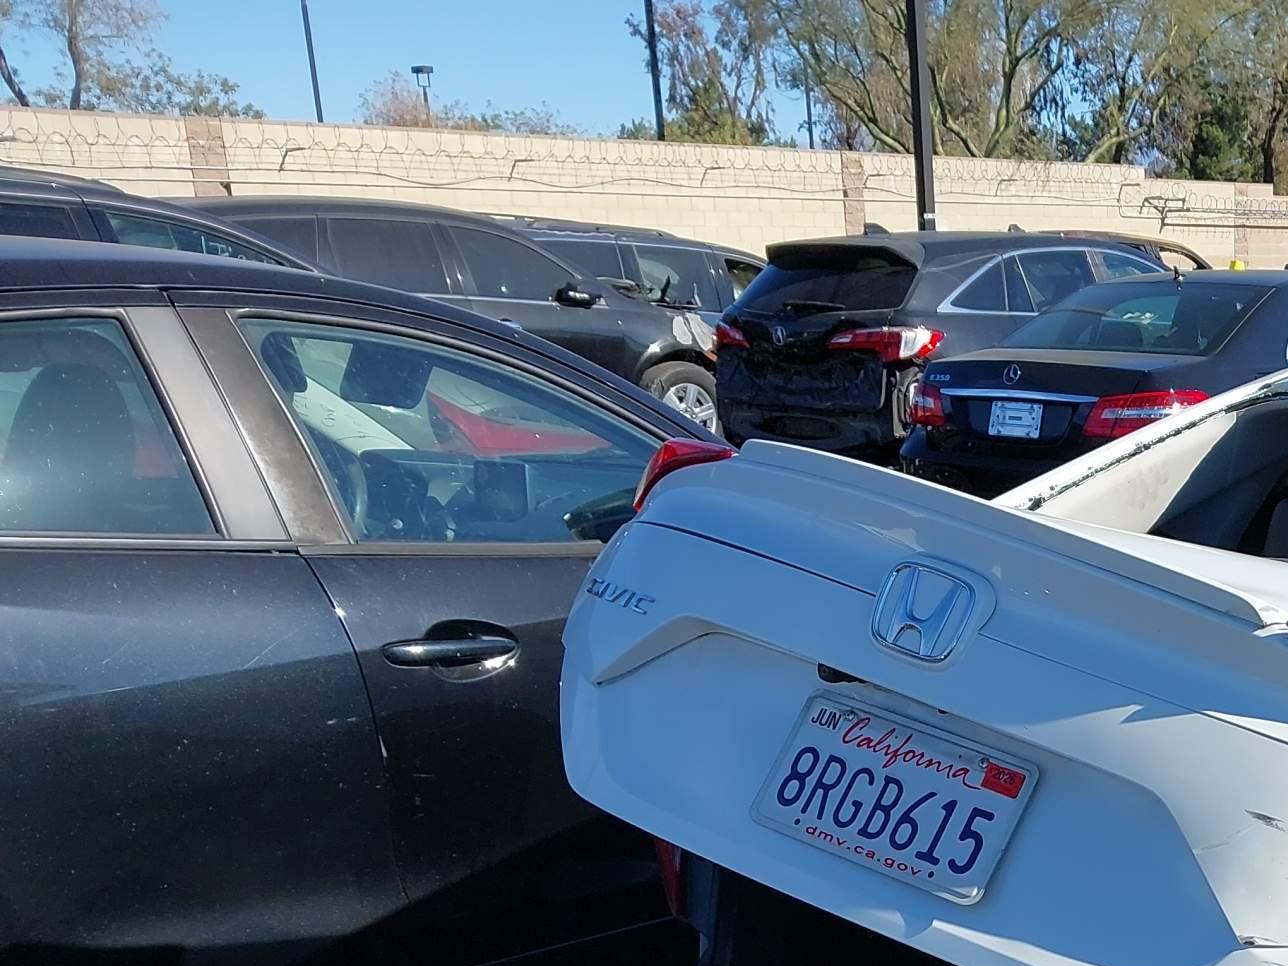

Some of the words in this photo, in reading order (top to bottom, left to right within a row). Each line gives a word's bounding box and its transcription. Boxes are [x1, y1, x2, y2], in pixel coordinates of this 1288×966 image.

[586, 577, 656, 615] CIVIC
[811, 707, 842, 730] JUN
[842, 717, 981, 790] California
[776, 746, 996, 875] 8RGB615
[805, 826, 922, 877] dmv.ca.gov
